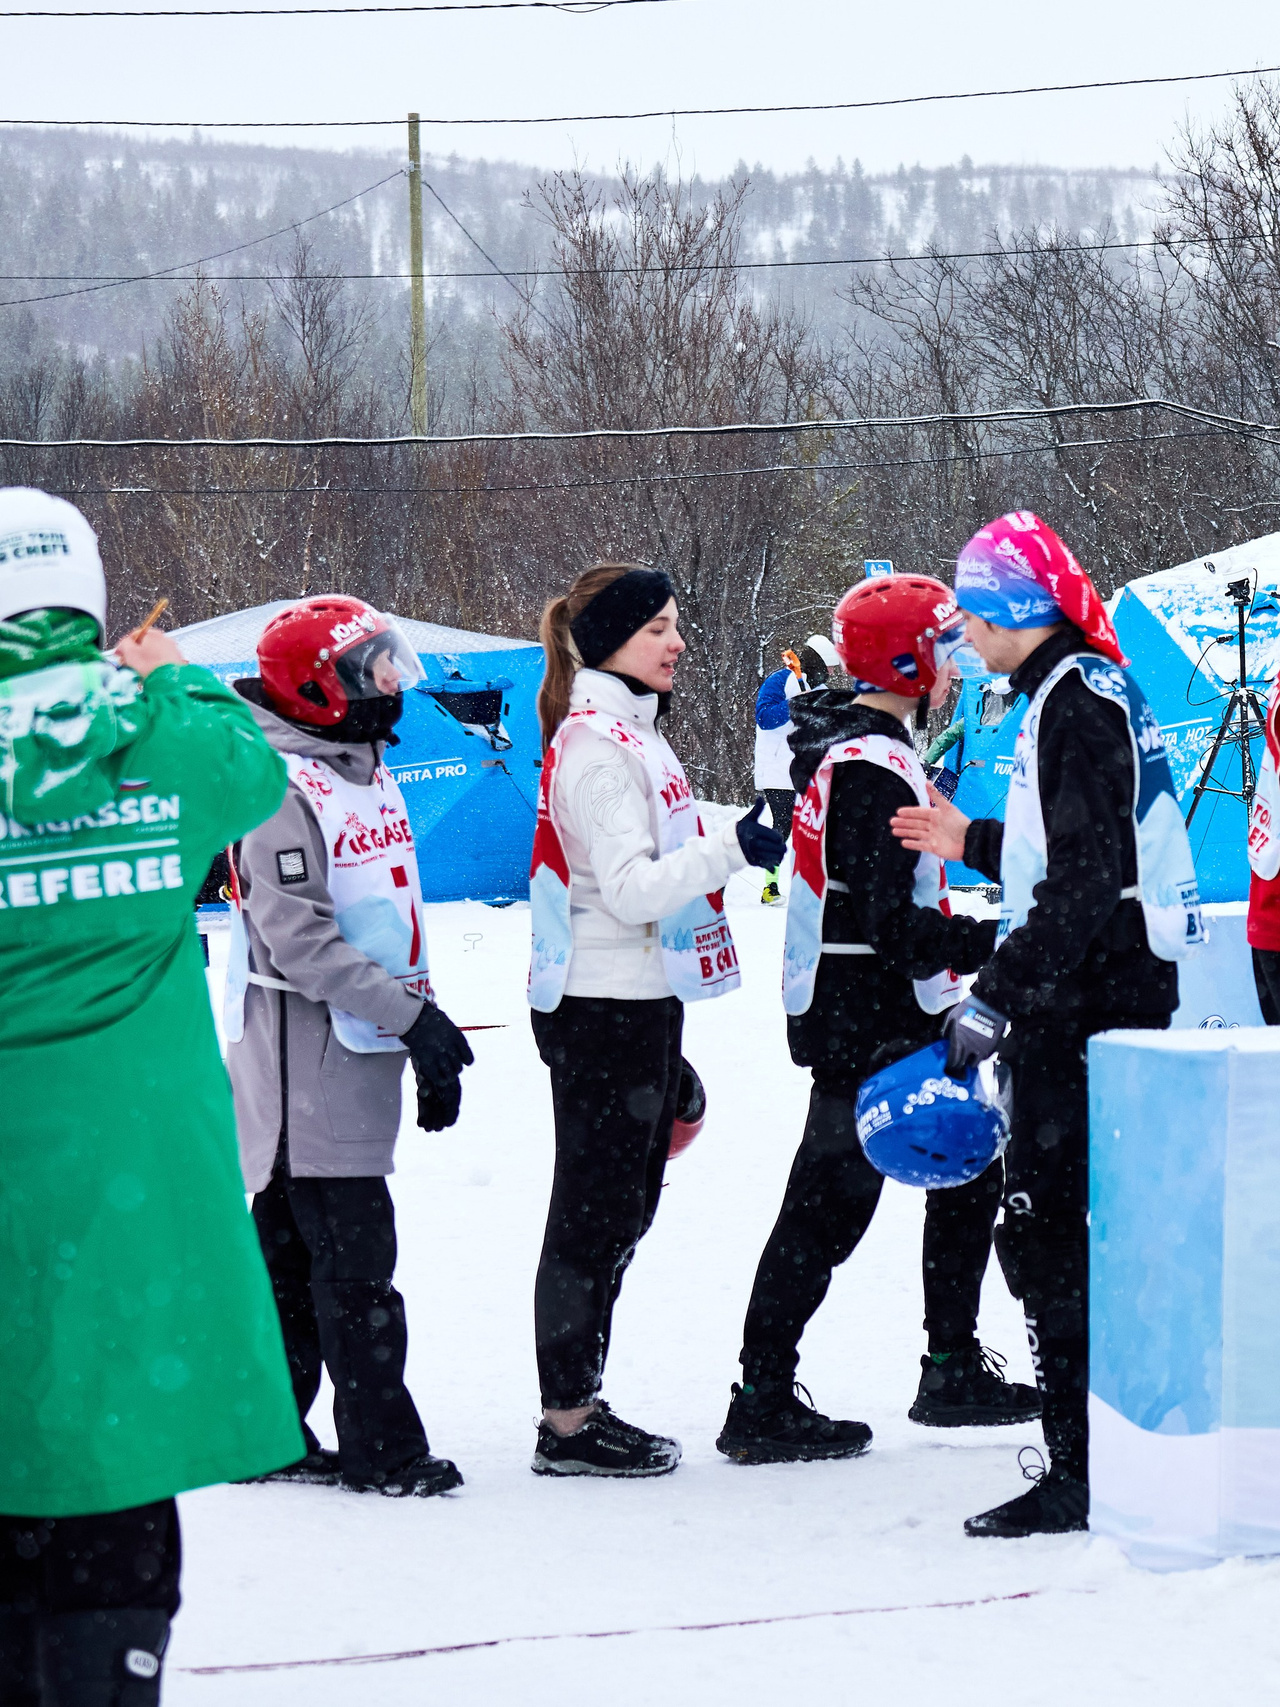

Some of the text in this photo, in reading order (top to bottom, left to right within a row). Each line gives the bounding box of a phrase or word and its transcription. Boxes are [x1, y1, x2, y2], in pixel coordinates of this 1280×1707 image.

[393, 763, 468, 785] URTA PRO
[700, 956, 714, 979] В
